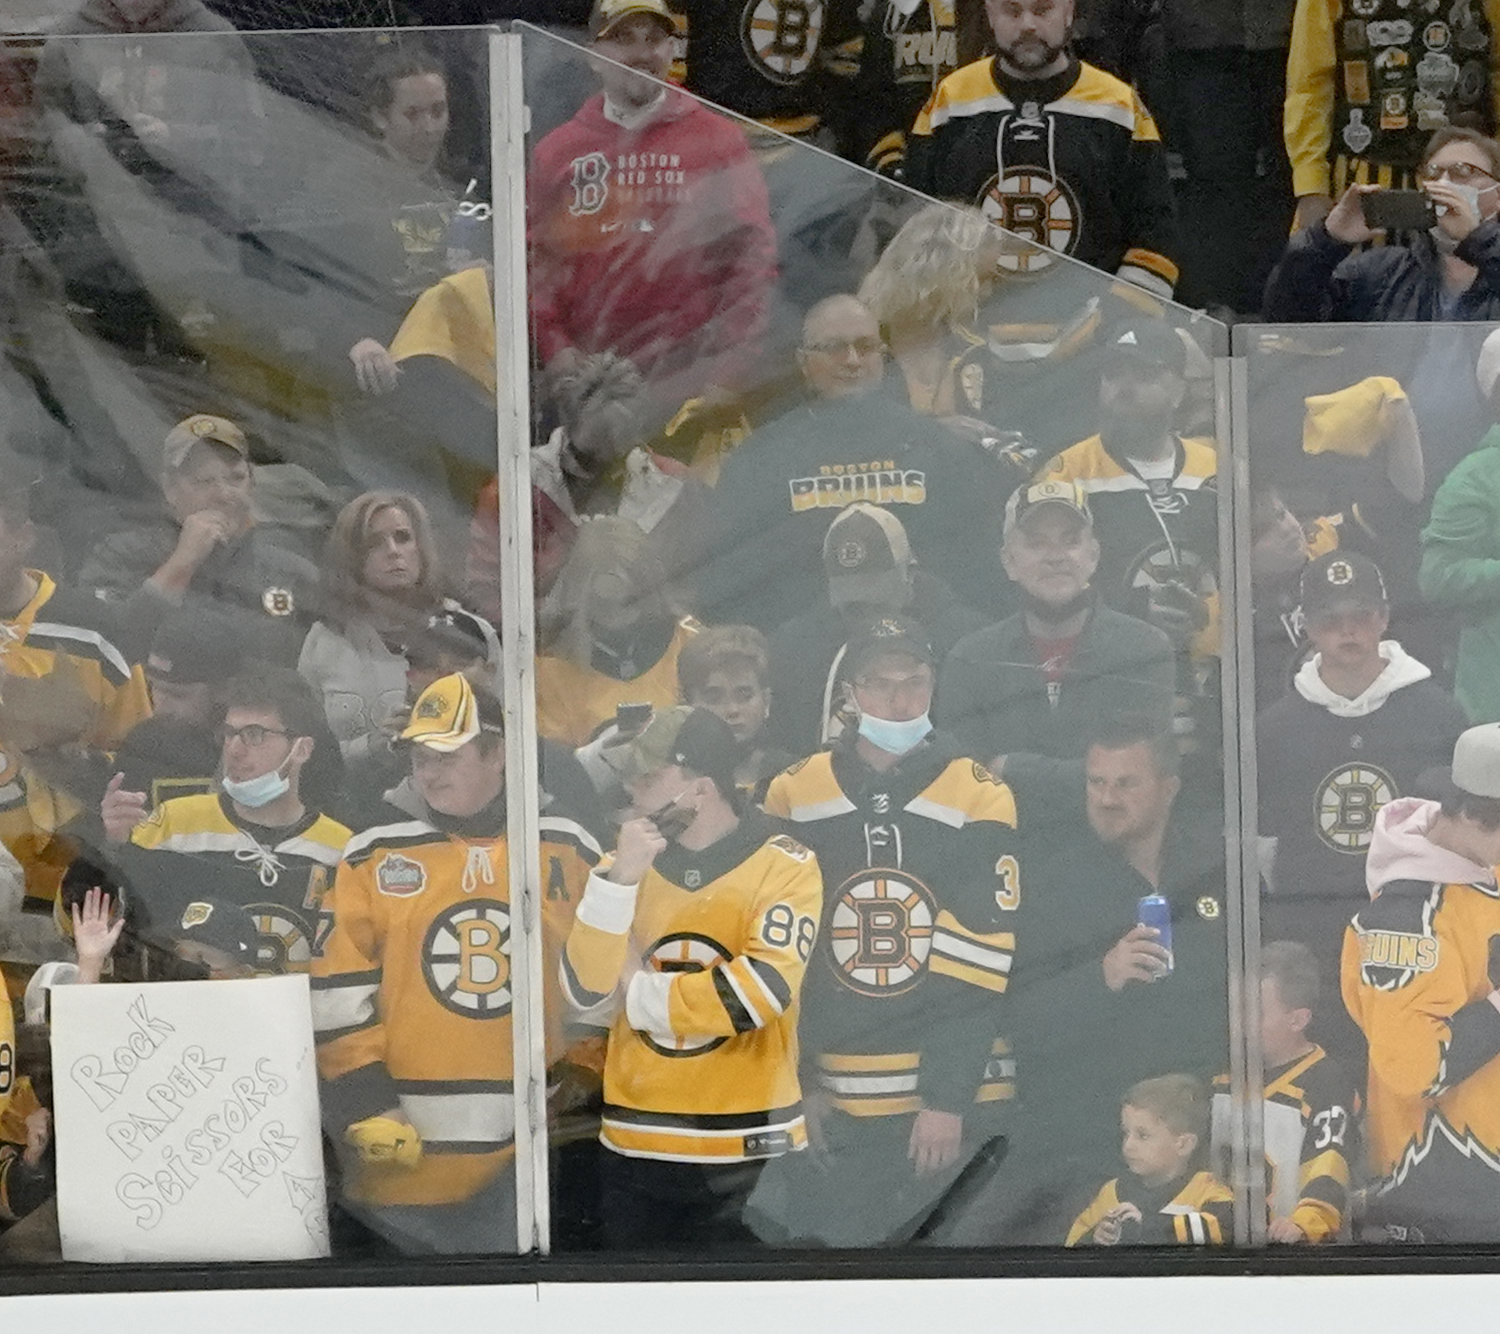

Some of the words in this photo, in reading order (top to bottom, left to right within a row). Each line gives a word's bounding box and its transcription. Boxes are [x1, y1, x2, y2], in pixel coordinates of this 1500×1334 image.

[568, 151, 609, 217] B
[617, 153, 680, 169] BOSTON
[618, 171, 642, 186] RED
[652, 171, 687, 187] SOX
[789, 470, 927, 513] BRUINS
[820, 461, 895, 476] BOSTON
[996, 854, 1021, 910] 3
[459, 921, 511, 993] B
[762, 903, 817, 965] 88
[858, 897, 910, 964] B
[1363, 931, 1438, 970] UINS
[106, 1044, 227, 1162] PAPER
[218, 1120, 300, 1199] FOR
